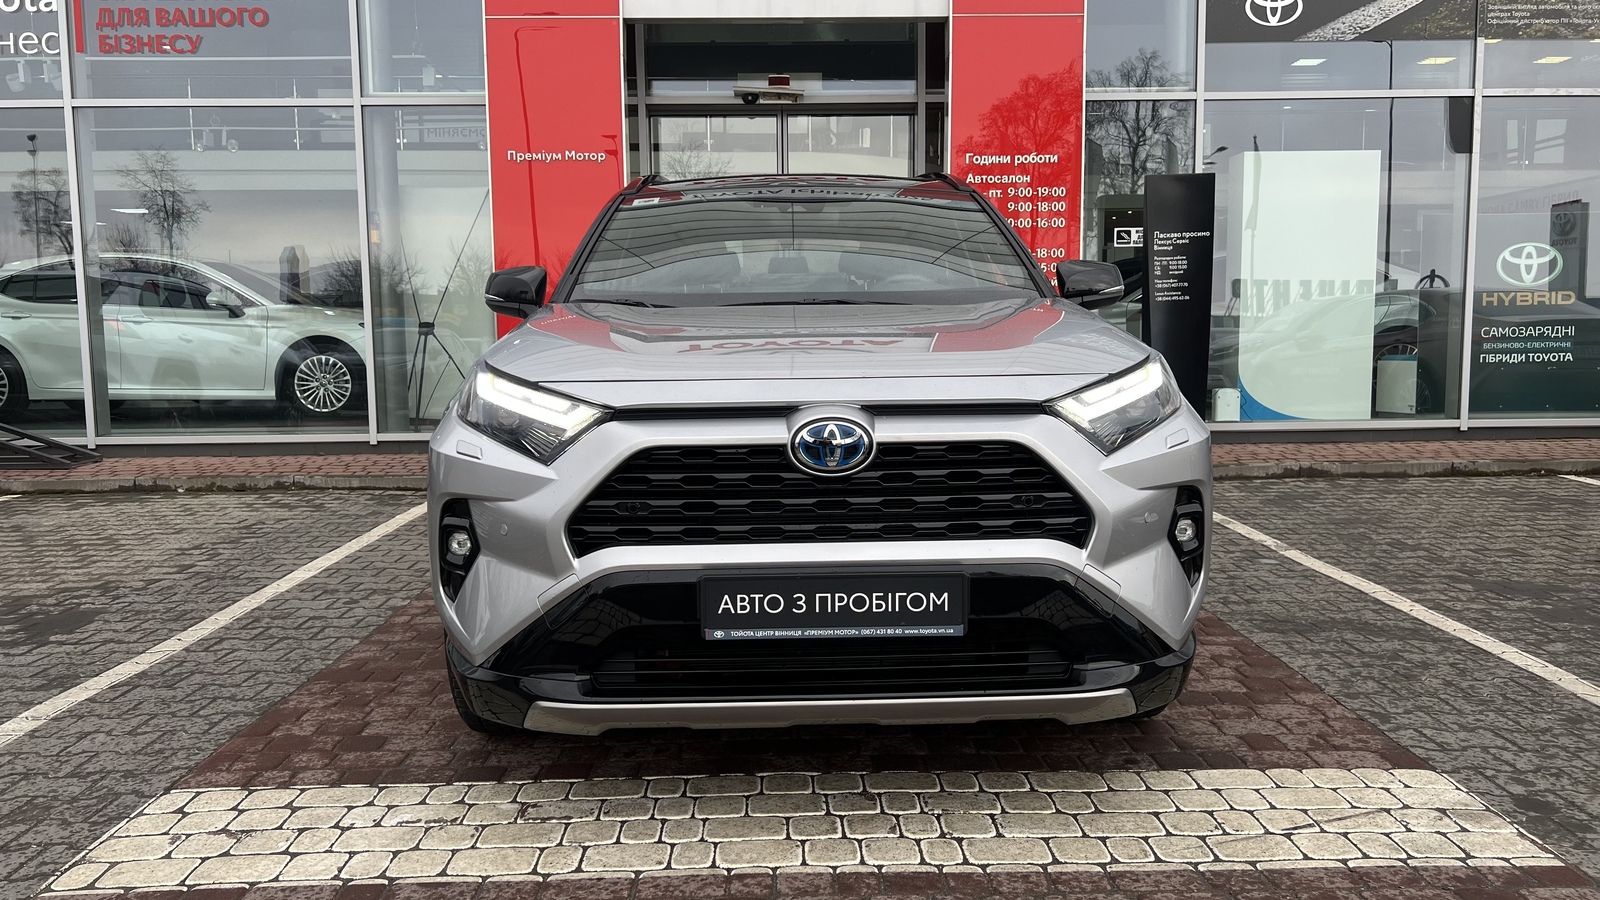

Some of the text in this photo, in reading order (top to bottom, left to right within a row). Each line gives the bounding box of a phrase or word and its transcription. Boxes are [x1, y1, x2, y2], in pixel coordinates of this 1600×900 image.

[96, 7, 269, 30] ДЛЯ ВАШОГО
[98, 34, 203, 54] БІЗНЕСУ
[507, 150, 606, 163] Преміум Мотор
[965, 152, 1058, 166] Години роботи
[966, 173, 1031, 184] Автосалон
[989, 190, 1003, 198] пт.
[1007, 187, 1066, 198] 9:00-19:00
[1007, 202, 1066, 212] 9:00-18:00
[1005, 217, 1066, 228] 0:00-16:00
[1482, 291, 1576, 306] HYBRID
[1481, 326, 1575, 339] САМОЗАРЯДНІ
[1483, 341, 1571, 349] БЕНЗИНОВО-ЕЛЕКТРИЧНІ
[1480, 352, 1573, 364] ГІБРИДИ TOYOTA
[717, 592, 949, 614] АВТО З ПРОБІГОМ
